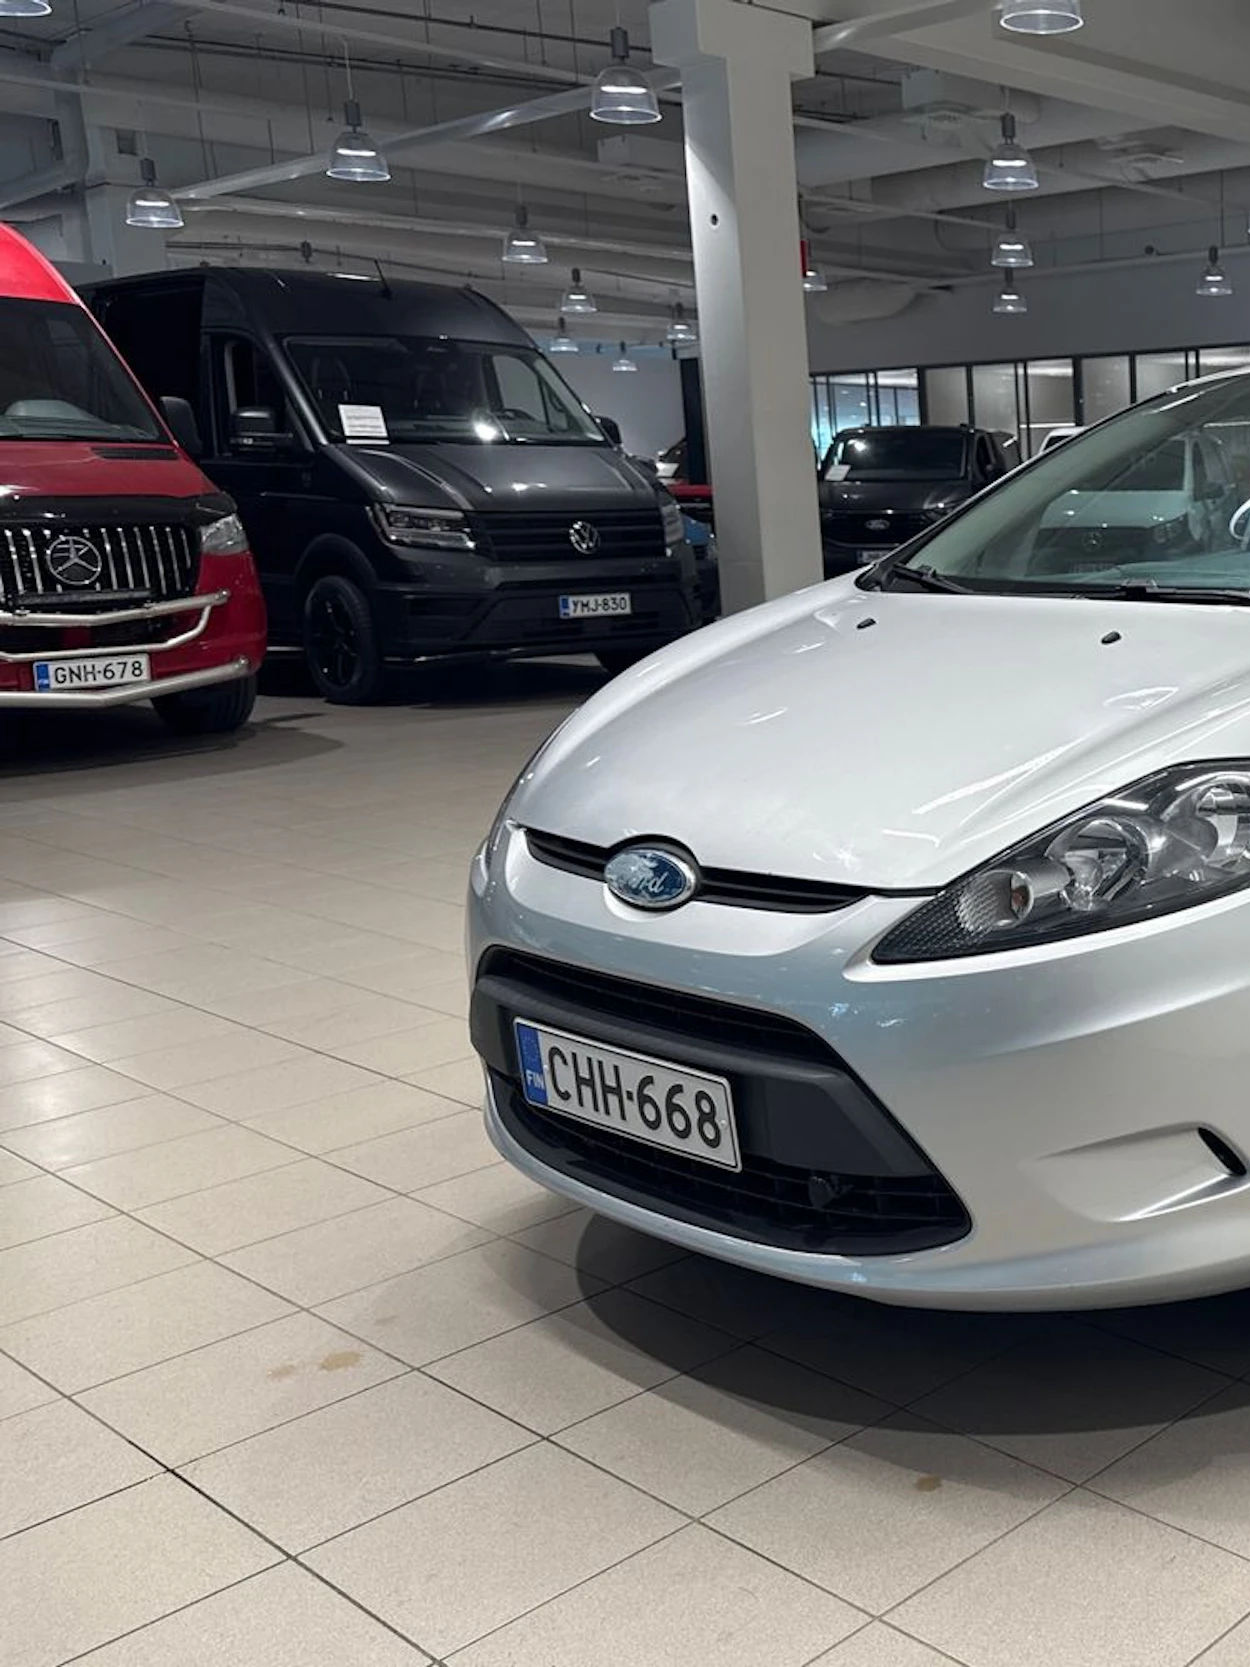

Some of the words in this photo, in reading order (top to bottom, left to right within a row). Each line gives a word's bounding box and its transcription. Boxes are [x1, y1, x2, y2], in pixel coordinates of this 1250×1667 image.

[54, 661, 143, 684] GNH-678
[526, 1068, 545, 1090] FIN
[548, 1046, 721, 1148] CHH-668
